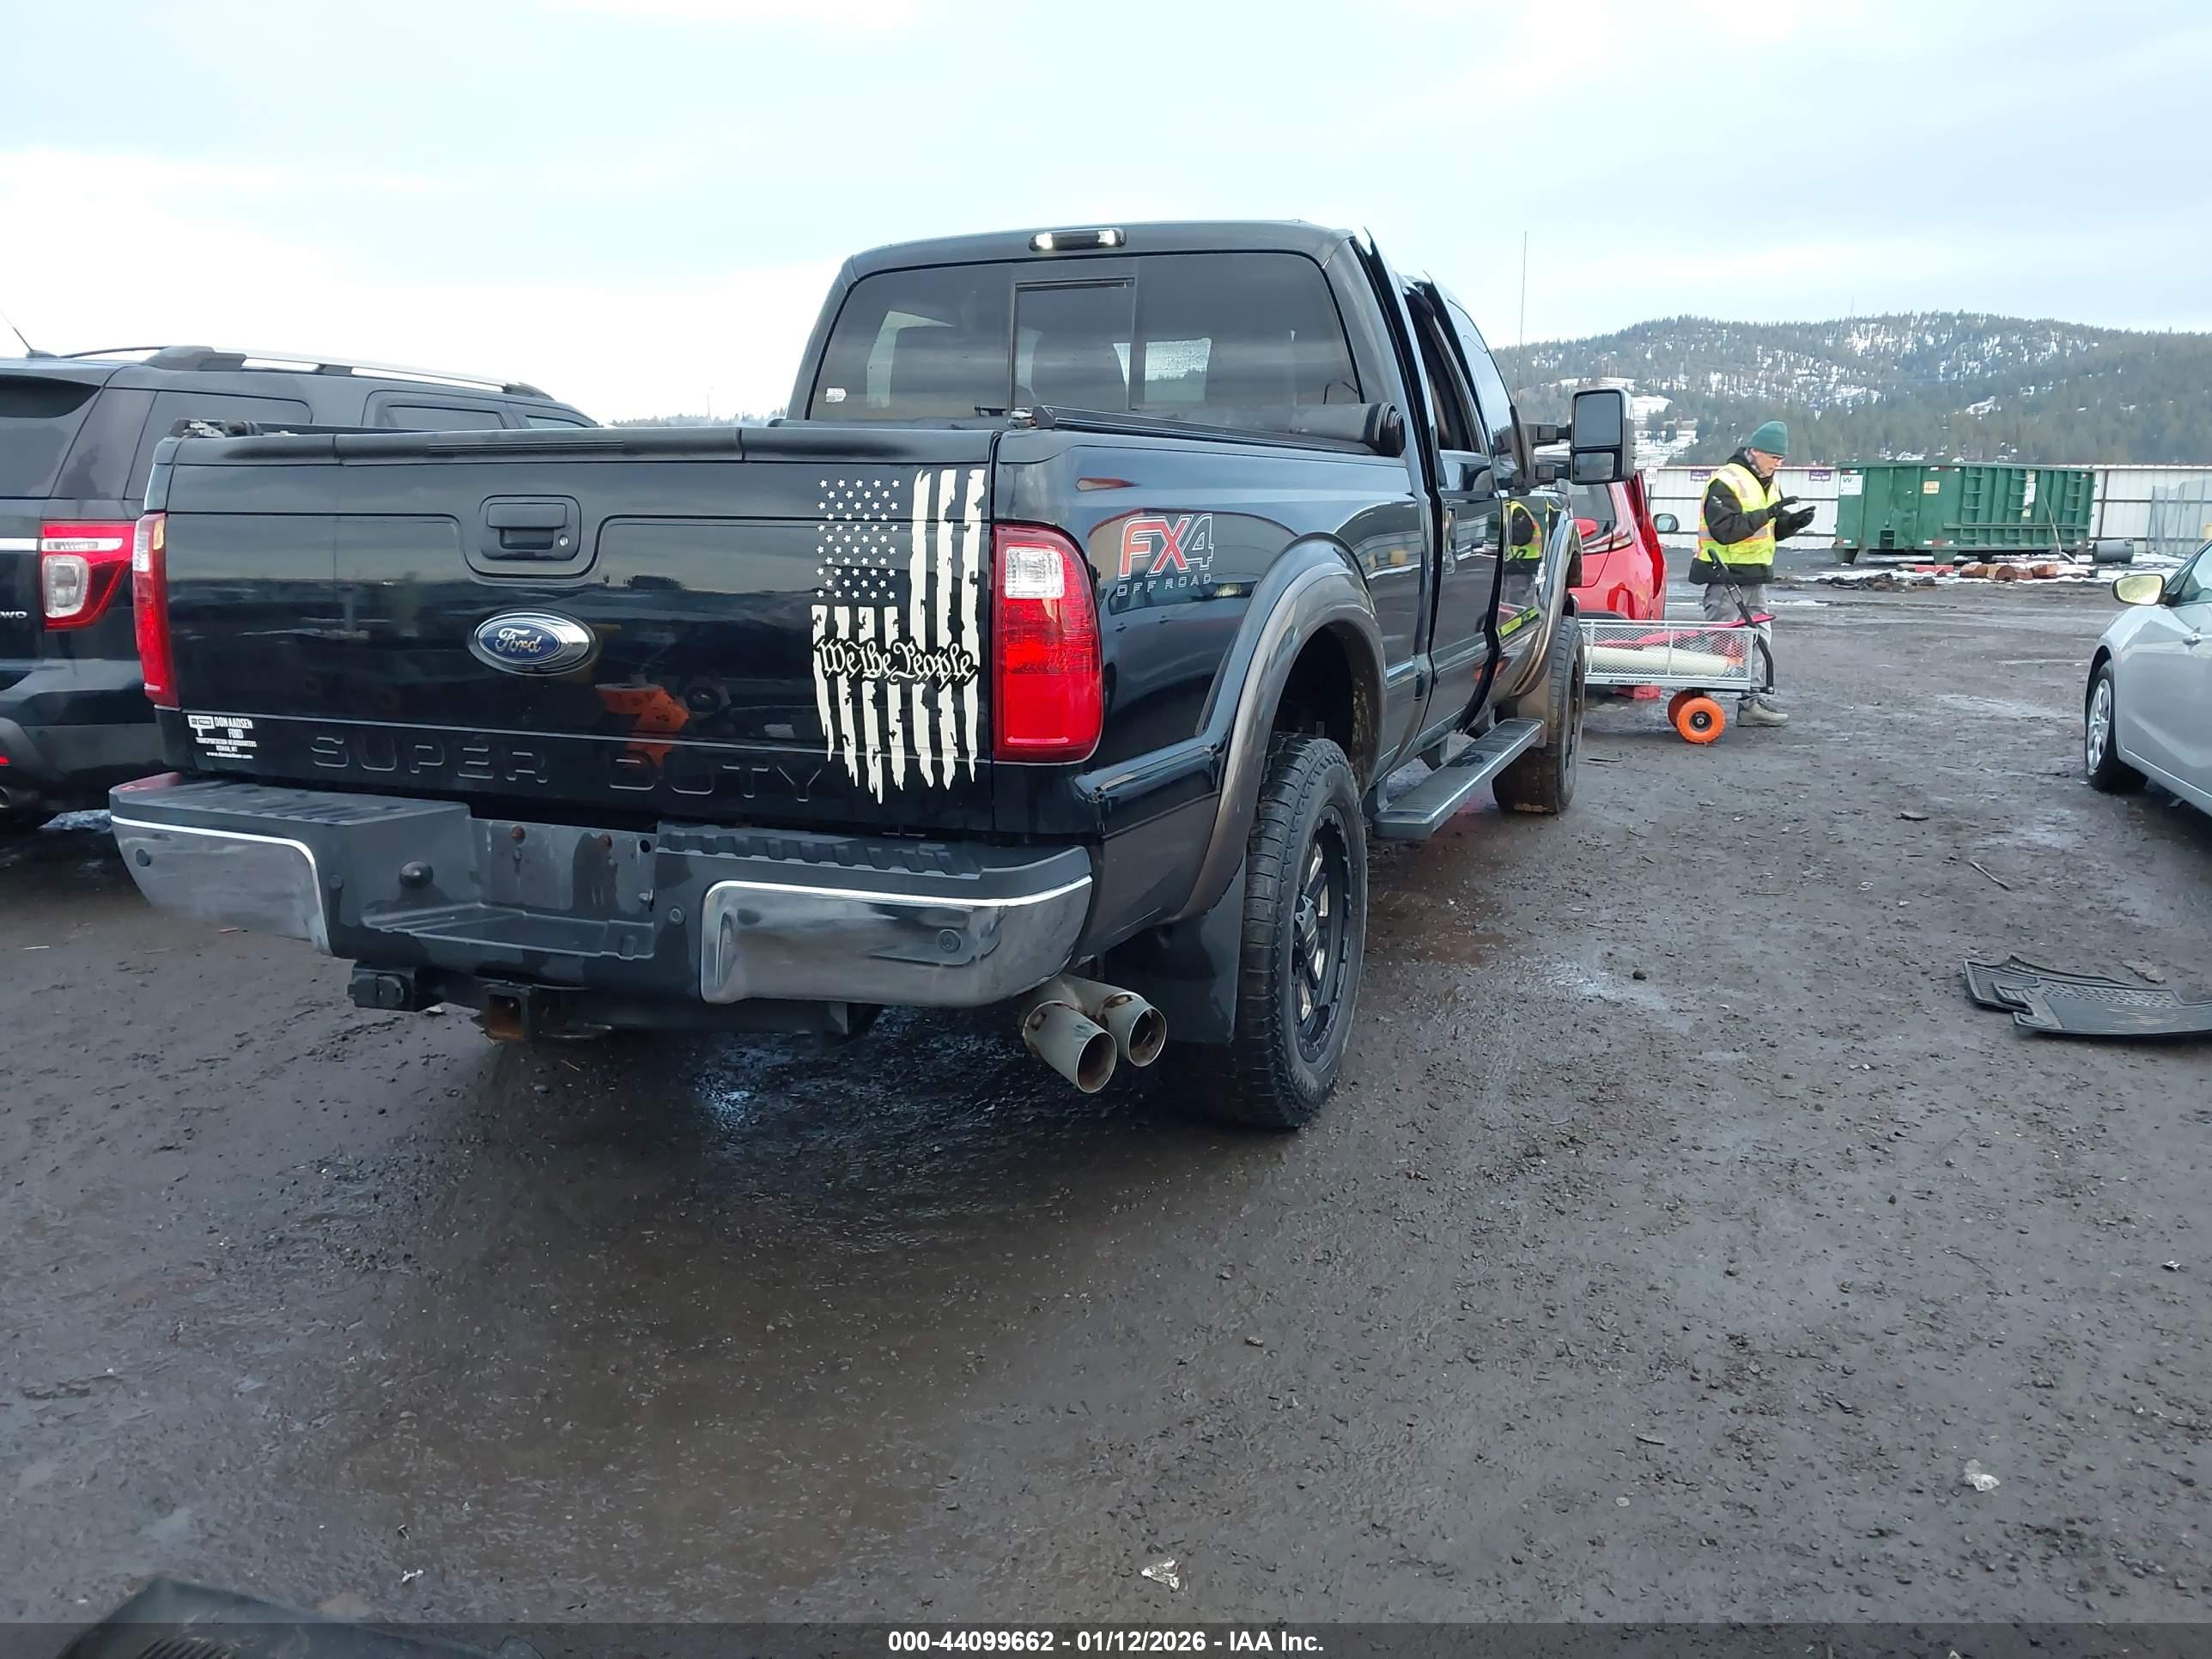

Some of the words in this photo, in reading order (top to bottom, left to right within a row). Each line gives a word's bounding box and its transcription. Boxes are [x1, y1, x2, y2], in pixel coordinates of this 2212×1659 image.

[1118, 514, 1214, 580] FX4
[1116, 582, 1157, 597] OFF
[1164, 573, 1212, 590] ROAD
[495, 628, 543, 653] Ford
[817, 639, 861, 678] We
[890, 641, 975, 690] People
[214, 716, 228, 727] DON
[228, 718, 253, 729] AADSEN
[228, 728, 244, 738] FORD
[311, 736, 548, 783] SUPER
[608, 750, 822, 802] DUTY
